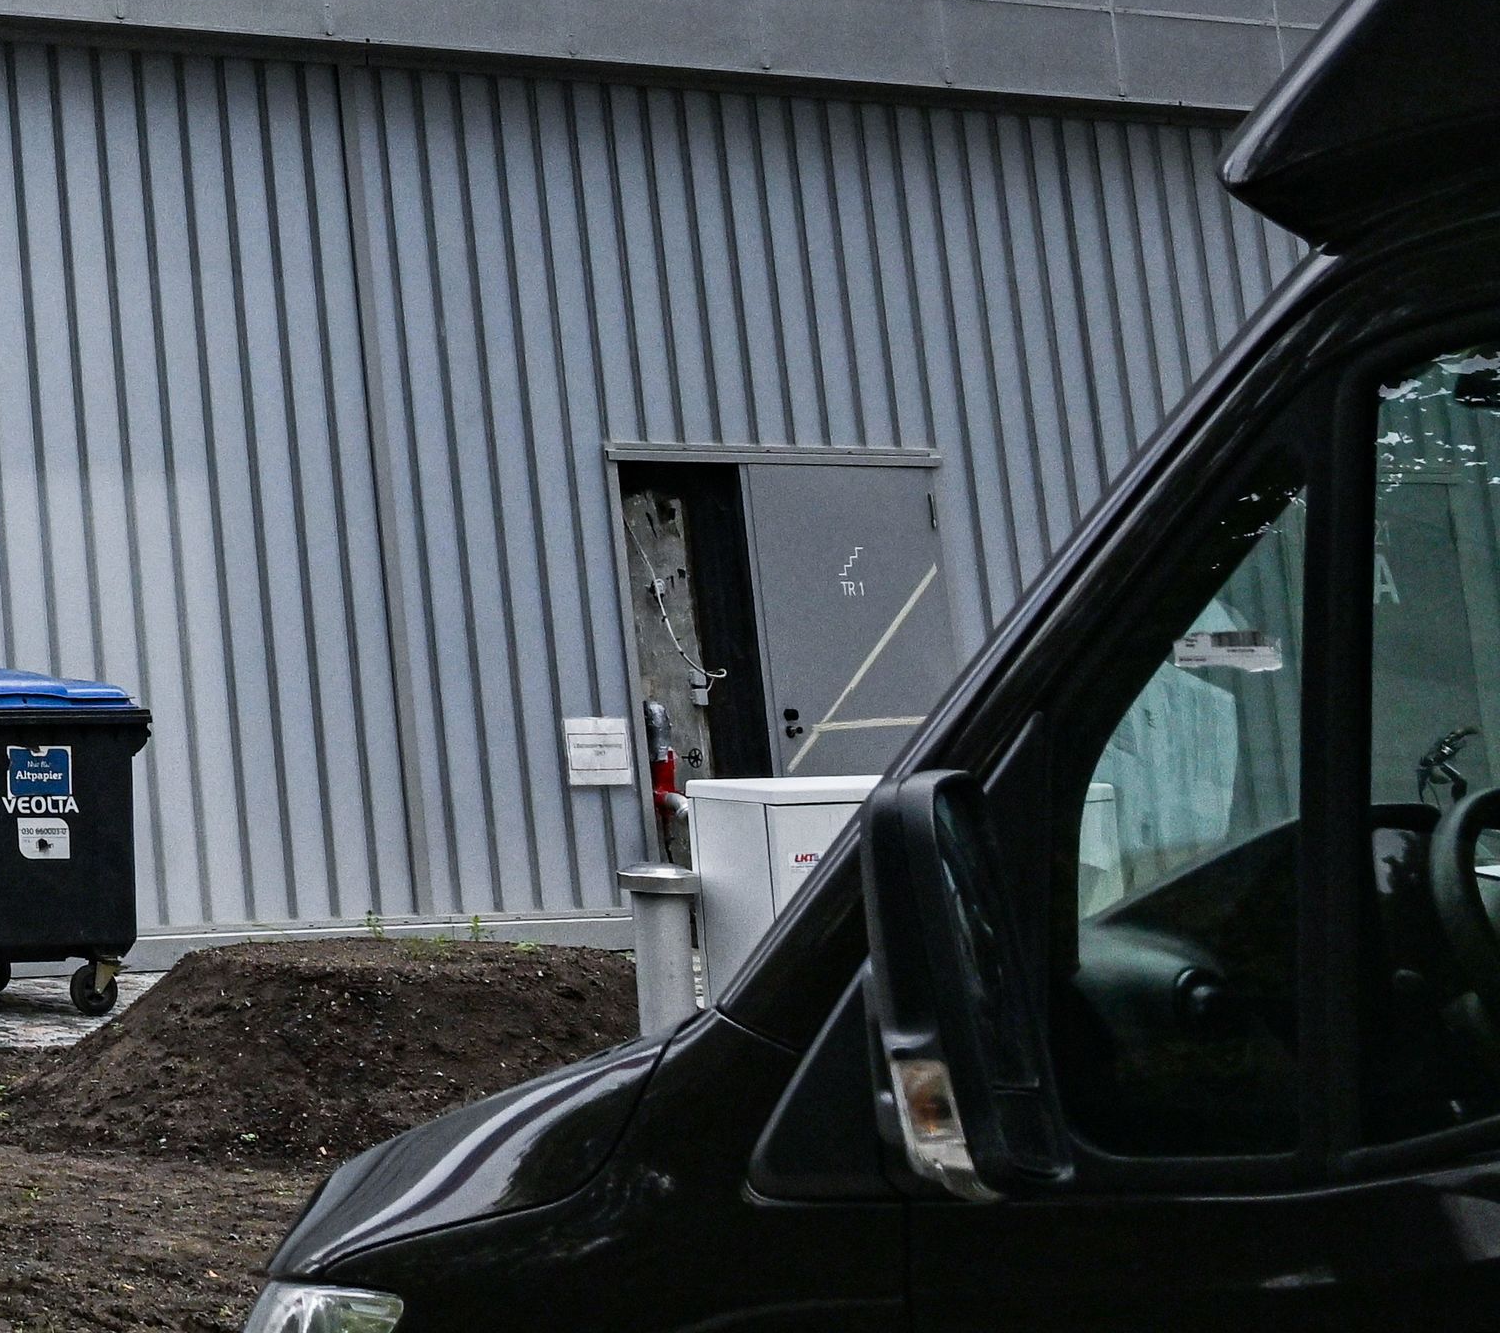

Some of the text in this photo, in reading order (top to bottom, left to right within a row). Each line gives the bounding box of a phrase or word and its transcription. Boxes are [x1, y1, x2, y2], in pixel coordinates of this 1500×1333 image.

[840, 581, 856, 596] TR
[15, 770, 63, 782] Altpapier
[1, 796, 80, 814] VEOLIA
